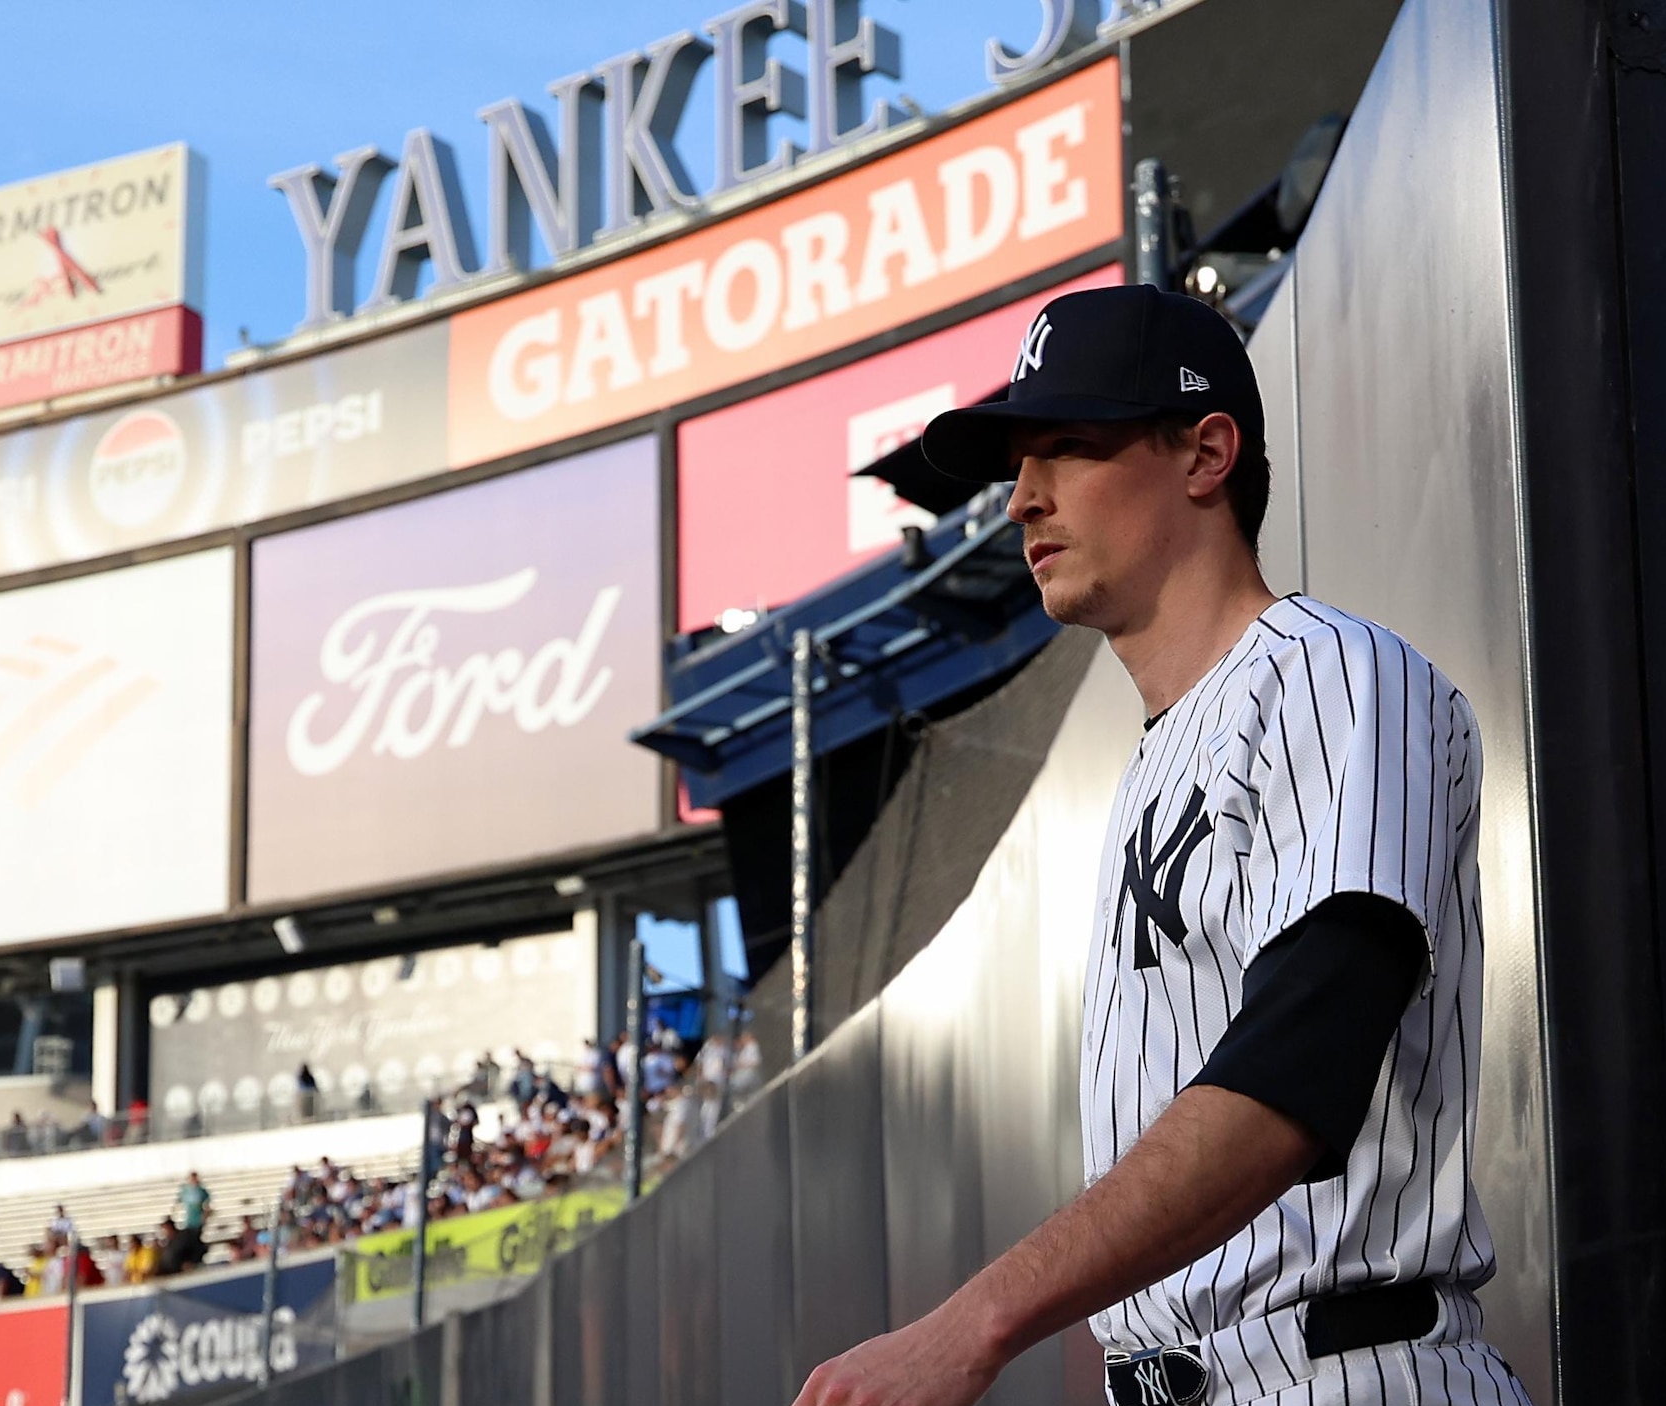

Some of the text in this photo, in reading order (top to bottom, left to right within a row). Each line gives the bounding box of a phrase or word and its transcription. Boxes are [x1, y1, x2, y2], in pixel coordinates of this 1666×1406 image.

[268, 0, 903, 329] YANKEE
[488, 105, 1087, 421] GATORADE
[97, 446, 180, 486] PEPSI
[242, 389, 384, 463] PEPSI
[286, 566, 623, 777] Ford
[1111, 783, 1215, 971] NY
[1134, 1360, 1168, 1406] NY
